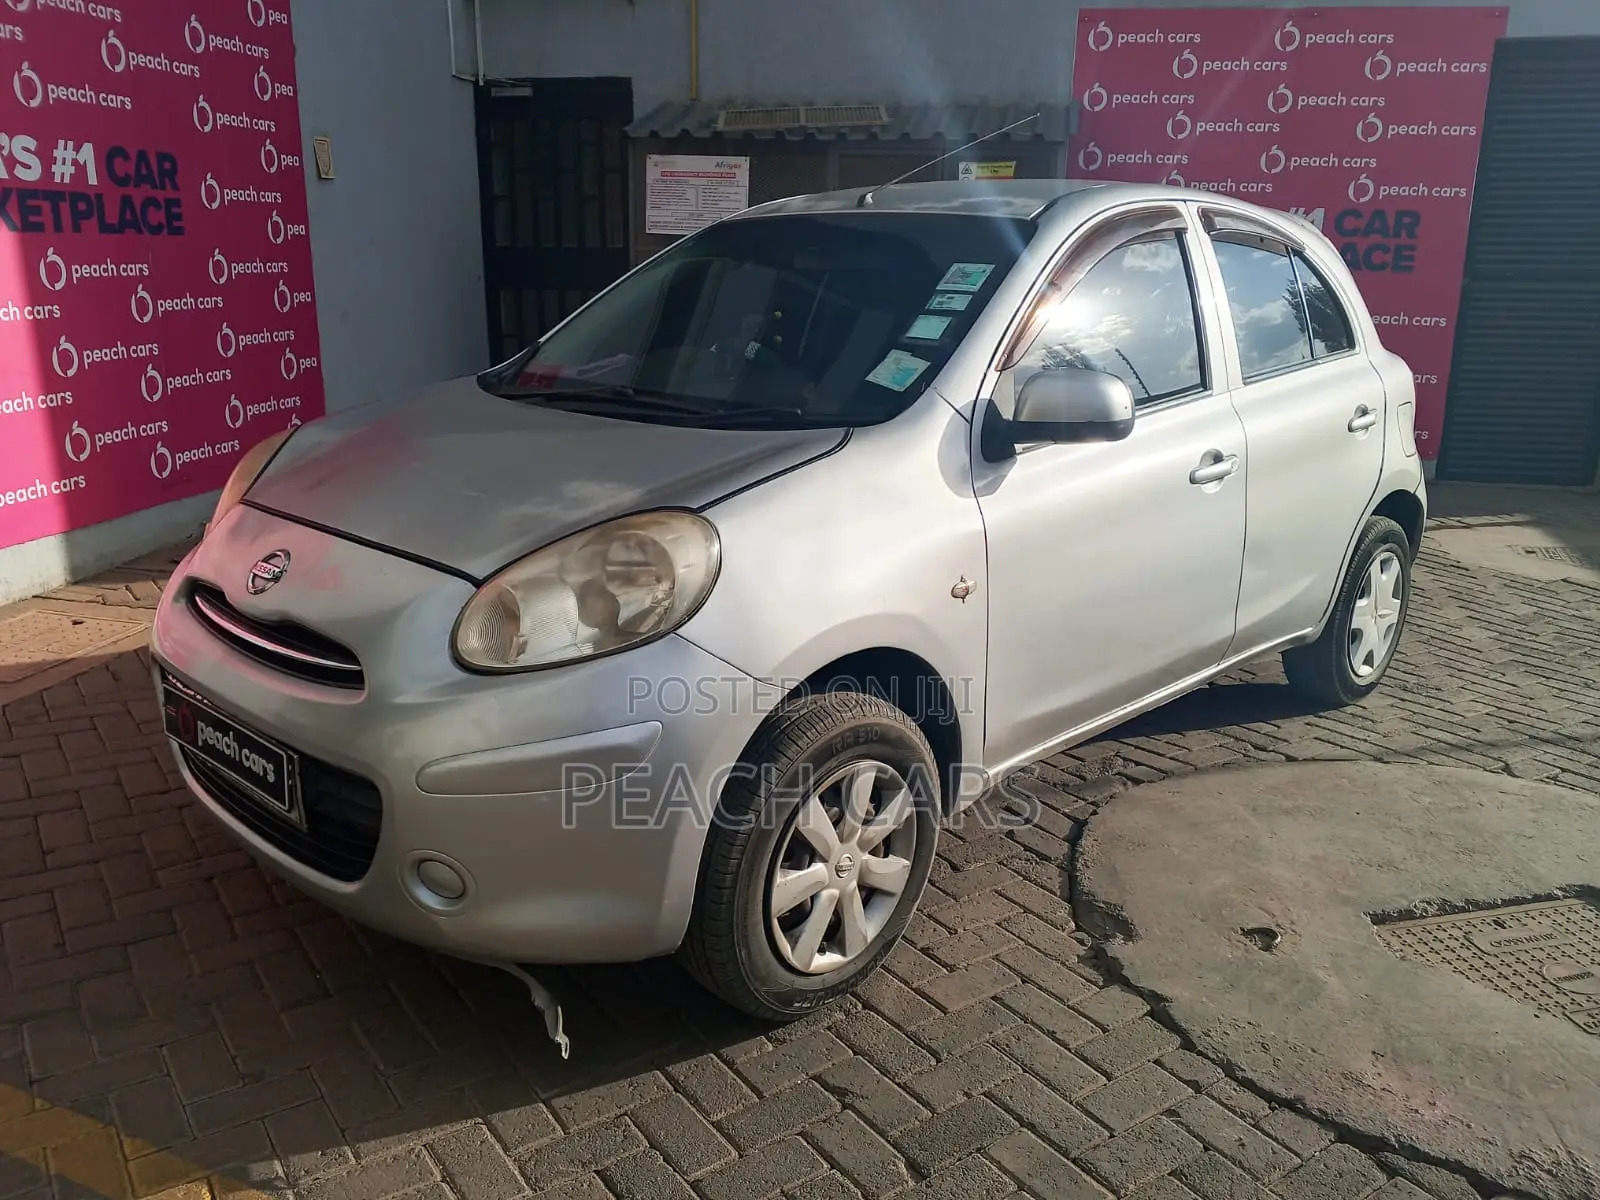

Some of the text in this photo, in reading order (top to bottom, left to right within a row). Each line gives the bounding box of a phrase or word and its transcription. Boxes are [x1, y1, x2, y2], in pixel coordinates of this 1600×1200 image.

[87, 2, 122, 23] cars
[268, 9, 288, 26] pea
[208, 34, 270, 60] peach cars
[1117, 28, 1201, 47] peach cars
[1305, 29, 1395, 48] peach cars
[128, 51, 201, 78] peach cars
[1202, 56, 1288, 75] peach cars
[1396, 57, 1488, 77] peach cars
[47, 83, 132, 110] peach cars
[274, 83, 294, 98] pea
[1112, 89, 1195, 108] peach cars
[1297, 91, 1386, 110] peach cars
[215, 111, 276, 132] peach cars
[1195, 117, 1280, 136] peach cars
[1387, 120, 1477, 139] peach cars
[0, 132, 180, 191] 'S #1 CAR
[280, 154, 300, 170] pea
[1106, 149, 1189, 167] peach cars
[1289, 152, 1377, 171] peach cars
[223, 186, 282, 206] peach cars
[1239, 182, 1273, 194] cars
[1378, 182, 1467, 200] peach cars
[287, 224, 306, 238] pea
[1289, 207, 1421, 239] 1 CAR
[71, 257, 150, 285] peach cars
[231, 257, 289, 277] peach cars
[157, 292, 224, 318] peach cars
[293, 291, 312, 304] pea
[23, 304, 61, 320] cars
[1372, 312, 1447, 328] each cars
[238, 327, 295, 351] peach cars
[82, 340, 159, 370] peach cars
[299, 356, 318, 374] pea
[166, 367, 232, 395] peach cars
[1413, 373, 1438, 385] ars
[0, 391, 73, 413] ach cars
[246, 395, 301, 421] peach cars
[94, 420, 169, 453] peach cars
[175, 439, 240, 471] peach cars
[50, 475, 86, 495] cars
[197, 720, 275, 783] peach cars
